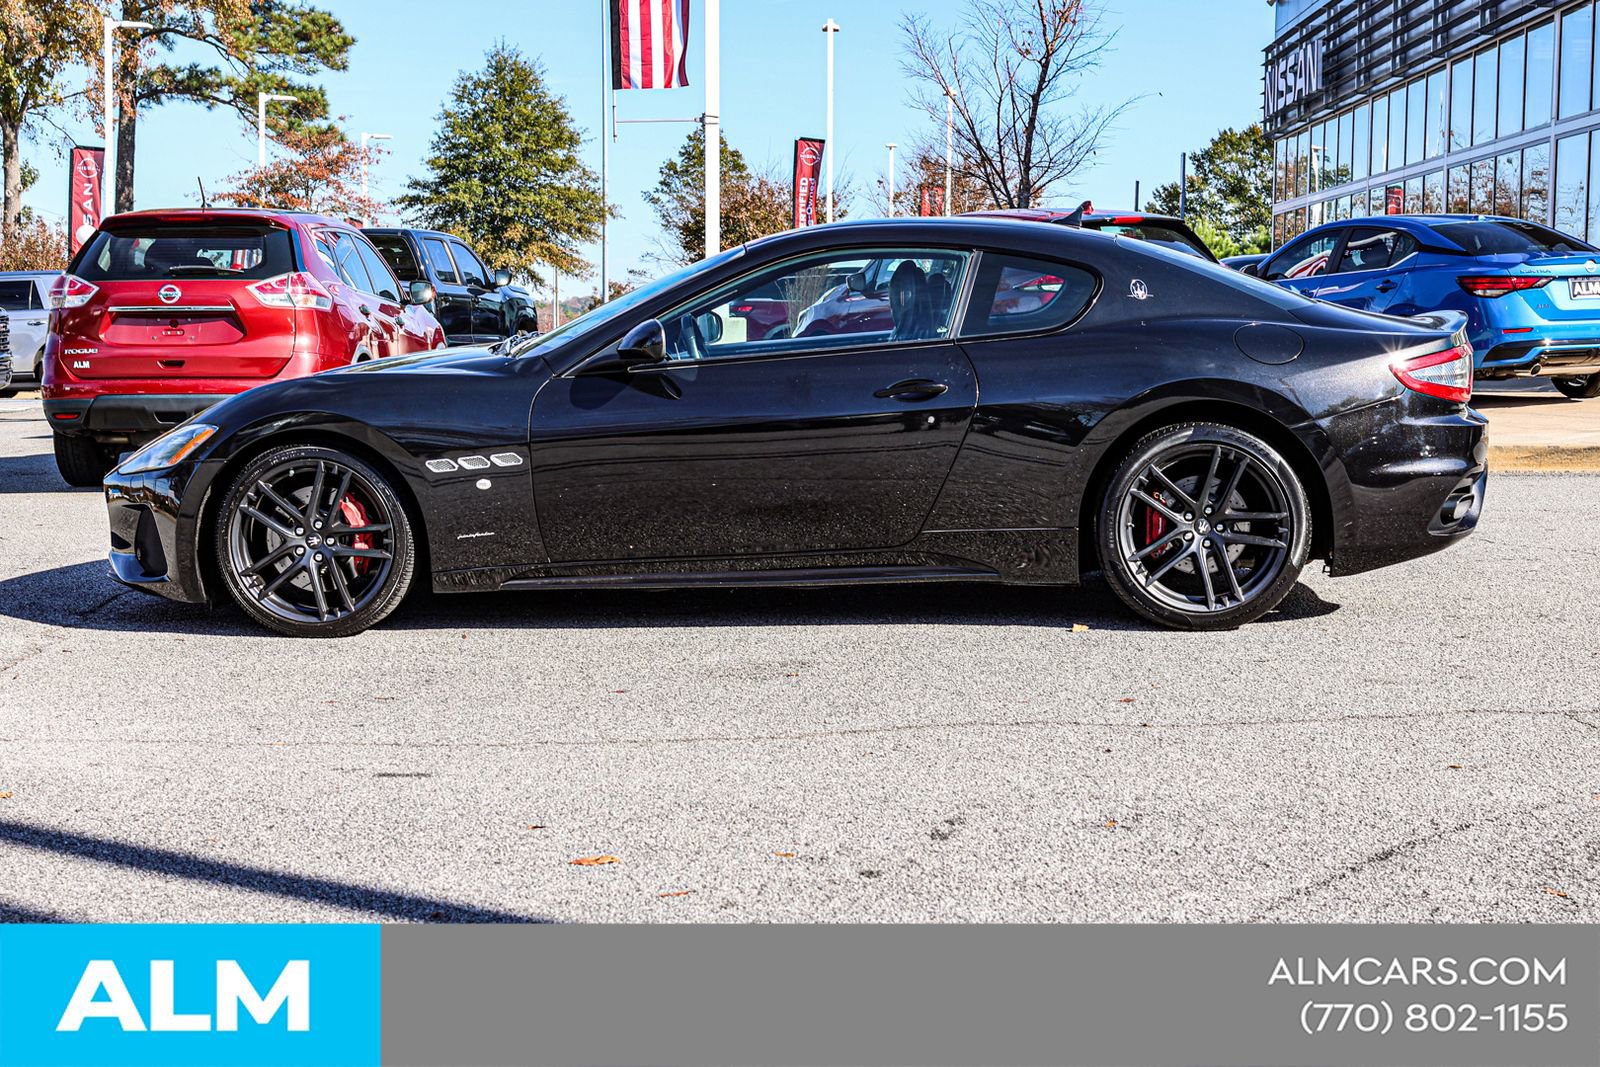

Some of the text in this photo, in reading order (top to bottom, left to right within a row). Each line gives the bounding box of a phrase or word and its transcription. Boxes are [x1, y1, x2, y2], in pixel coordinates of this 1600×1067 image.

[1264, 40, 1322, 118] NISSAN
[799, 177, 808, 228] ERTIFIED
[73, 361, 90, 369] ALM
